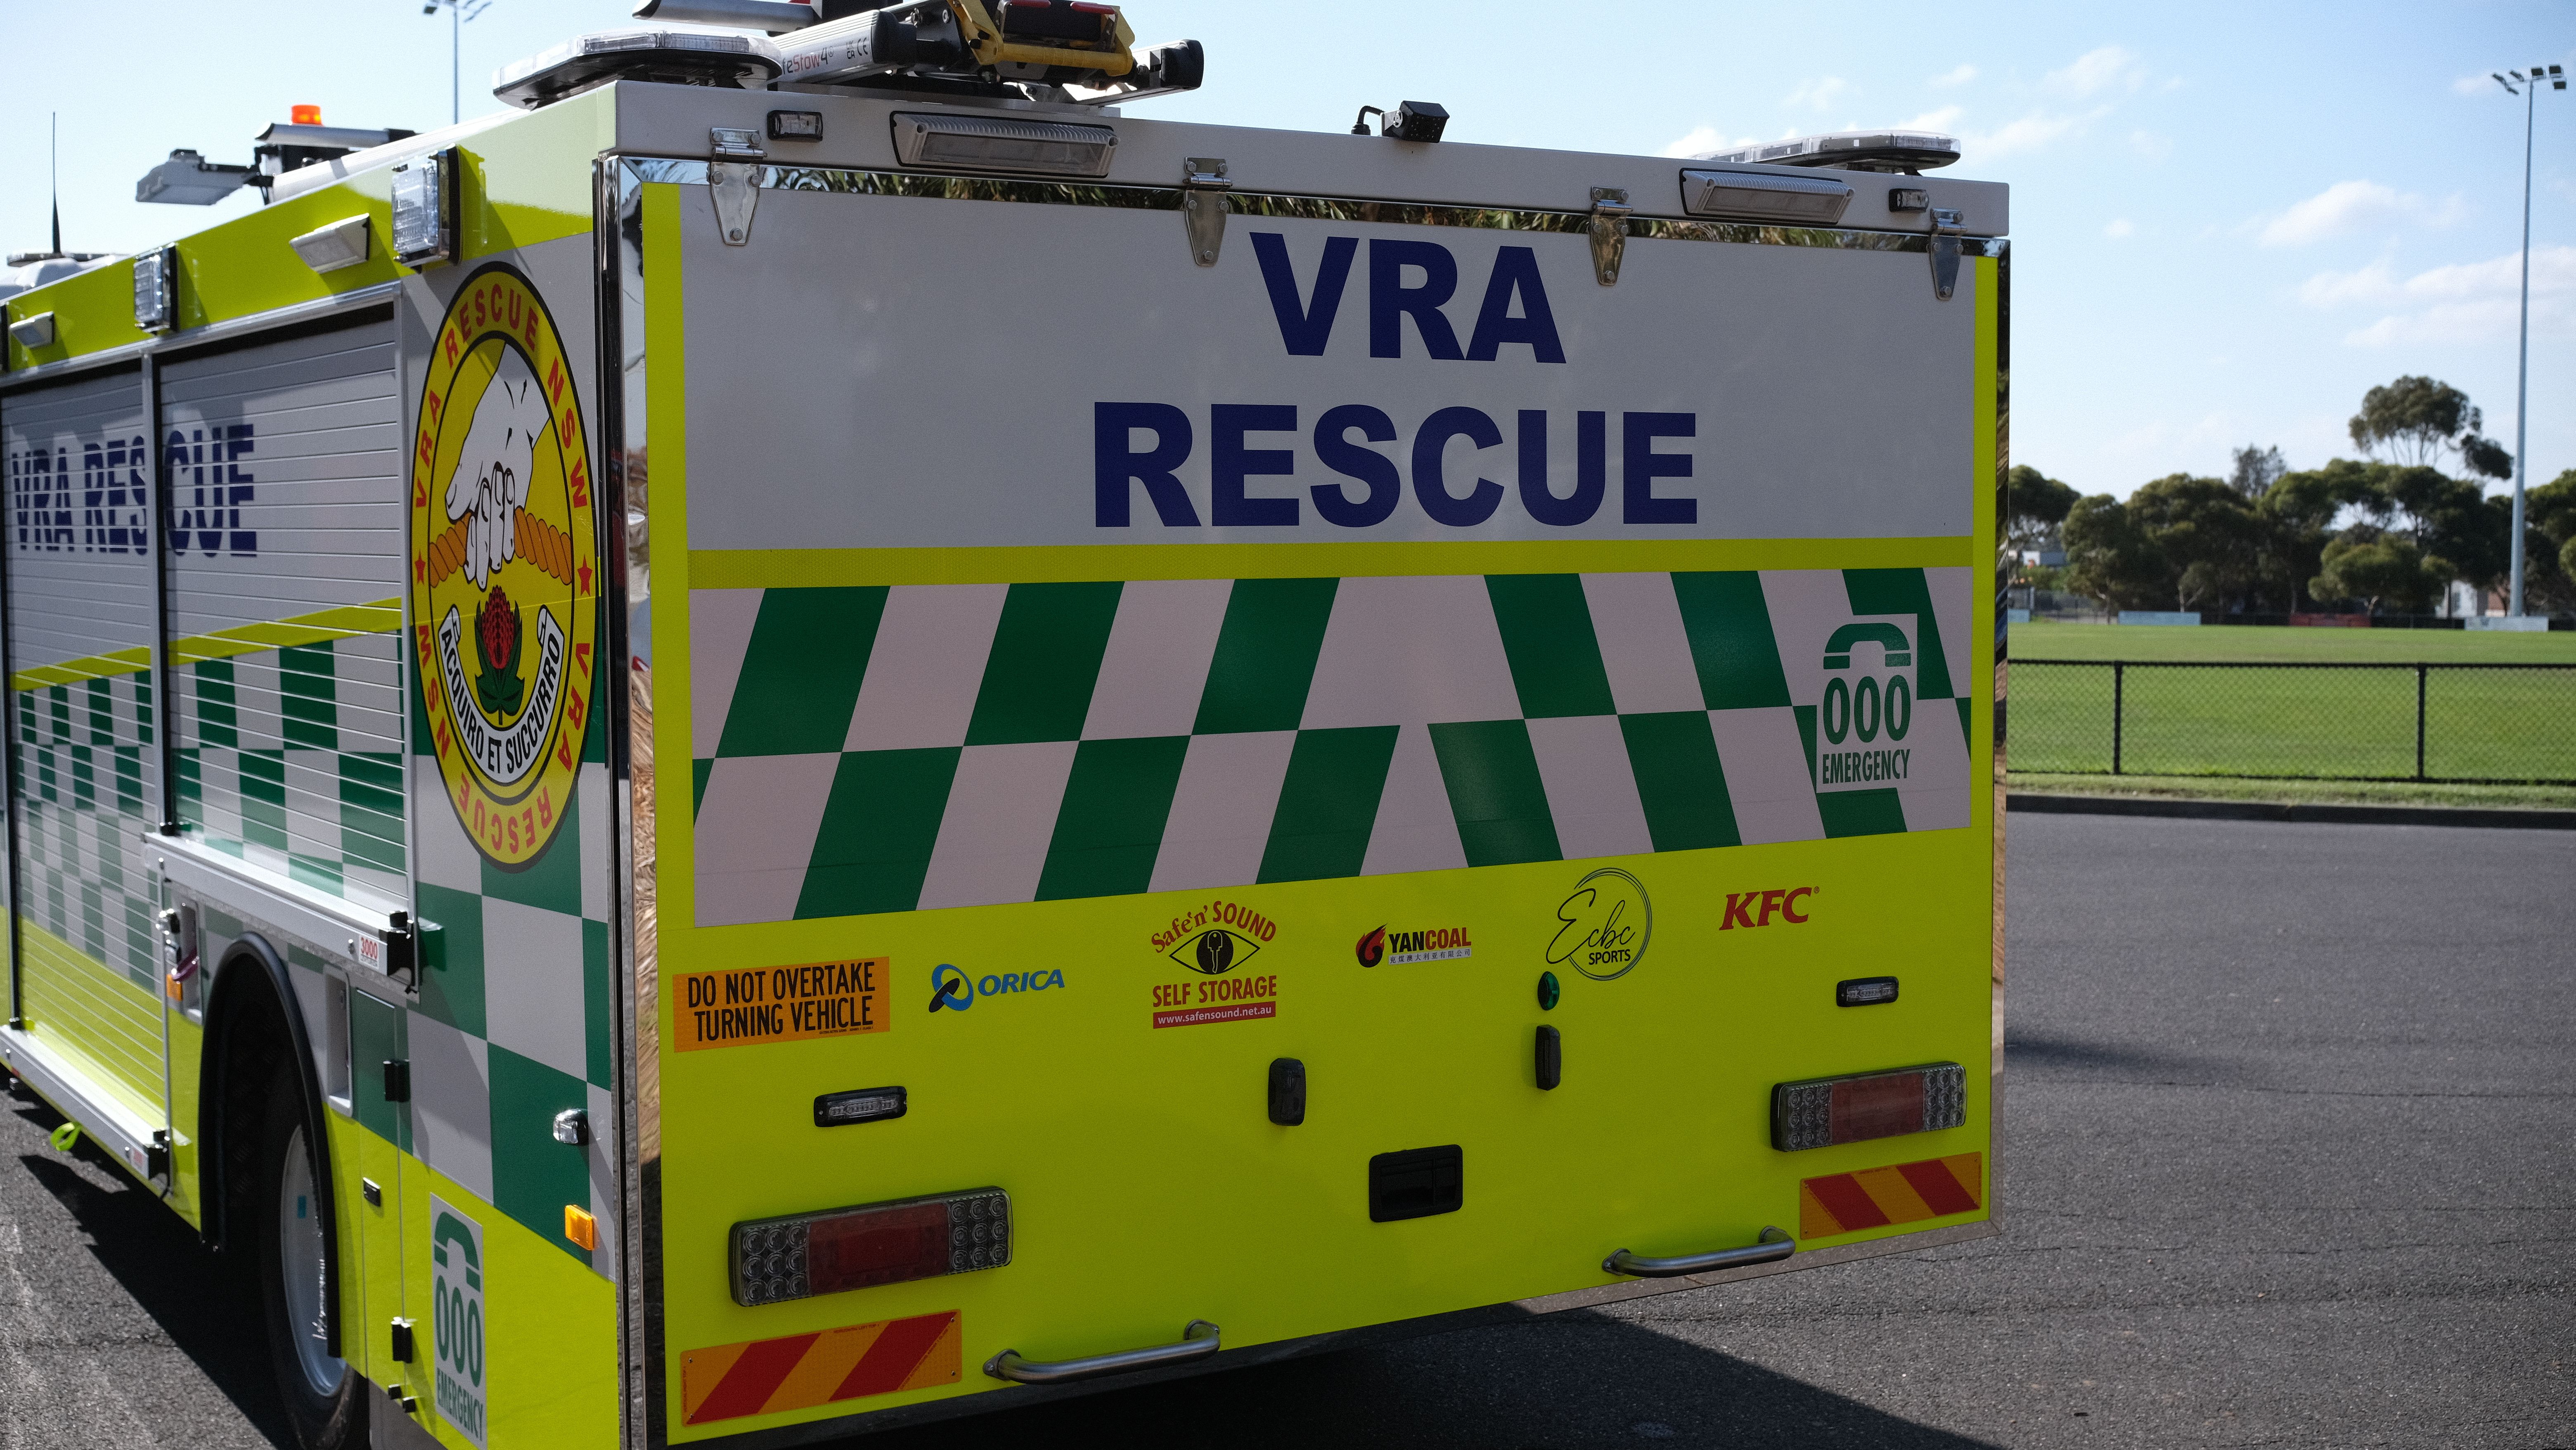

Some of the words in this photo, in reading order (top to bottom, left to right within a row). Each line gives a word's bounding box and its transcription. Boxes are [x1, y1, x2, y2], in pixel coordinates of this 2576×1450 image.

[1249, 232, 1567, 364] VRA
[416, 390, 441, 508] VRA
[445, 284, 539, 369] RESCUE
[547, 356, 588, 509] NSW
[12, 447, 75, 551] VRA
[84, 424, 257, 557] RESCUE
[1094, 401, 1698, 528] RESCUE
[419, 625, 451, 760] NSW
[441, 628, 485, 761] ACQUIRO
[488, 739, 502, 774] ET
[507, 632, 561, 775] SUCCURRO
[557, 642, 591, 772] VRA
[1823, 675, 1911, 744] 000
[1822, 749, 1910, 784] EMERGENCY
[458, 772, 553, 855] RESCUE
[360, 936, 378, 960] 3000
[1212, 900, 1276, 942] SOUND
[1388, 927, 1472, 953] YANCOAL
[688, 975, 717, 1008] DO
[725, 971, 766, 1005] NOT
[772, 962, 876, 1000] OVERTAKE
[978, 969, 1065, 996] ORICA
[1153, 983, 1191, 1007] SELF
[1199, 975, 1277, 1004] STORAGE
[1588, 949, 1631, 965] SPORTS
[694, 1003, 783, 1042] TURNING
[790, 995, 873, 1032] VEHICLE
[1158, 1006, 1272, 1024] www.safensound.net.au
[436, 1275, 482, 1388] 000
[437, 1366, 483, 1442] EMERGENCY
